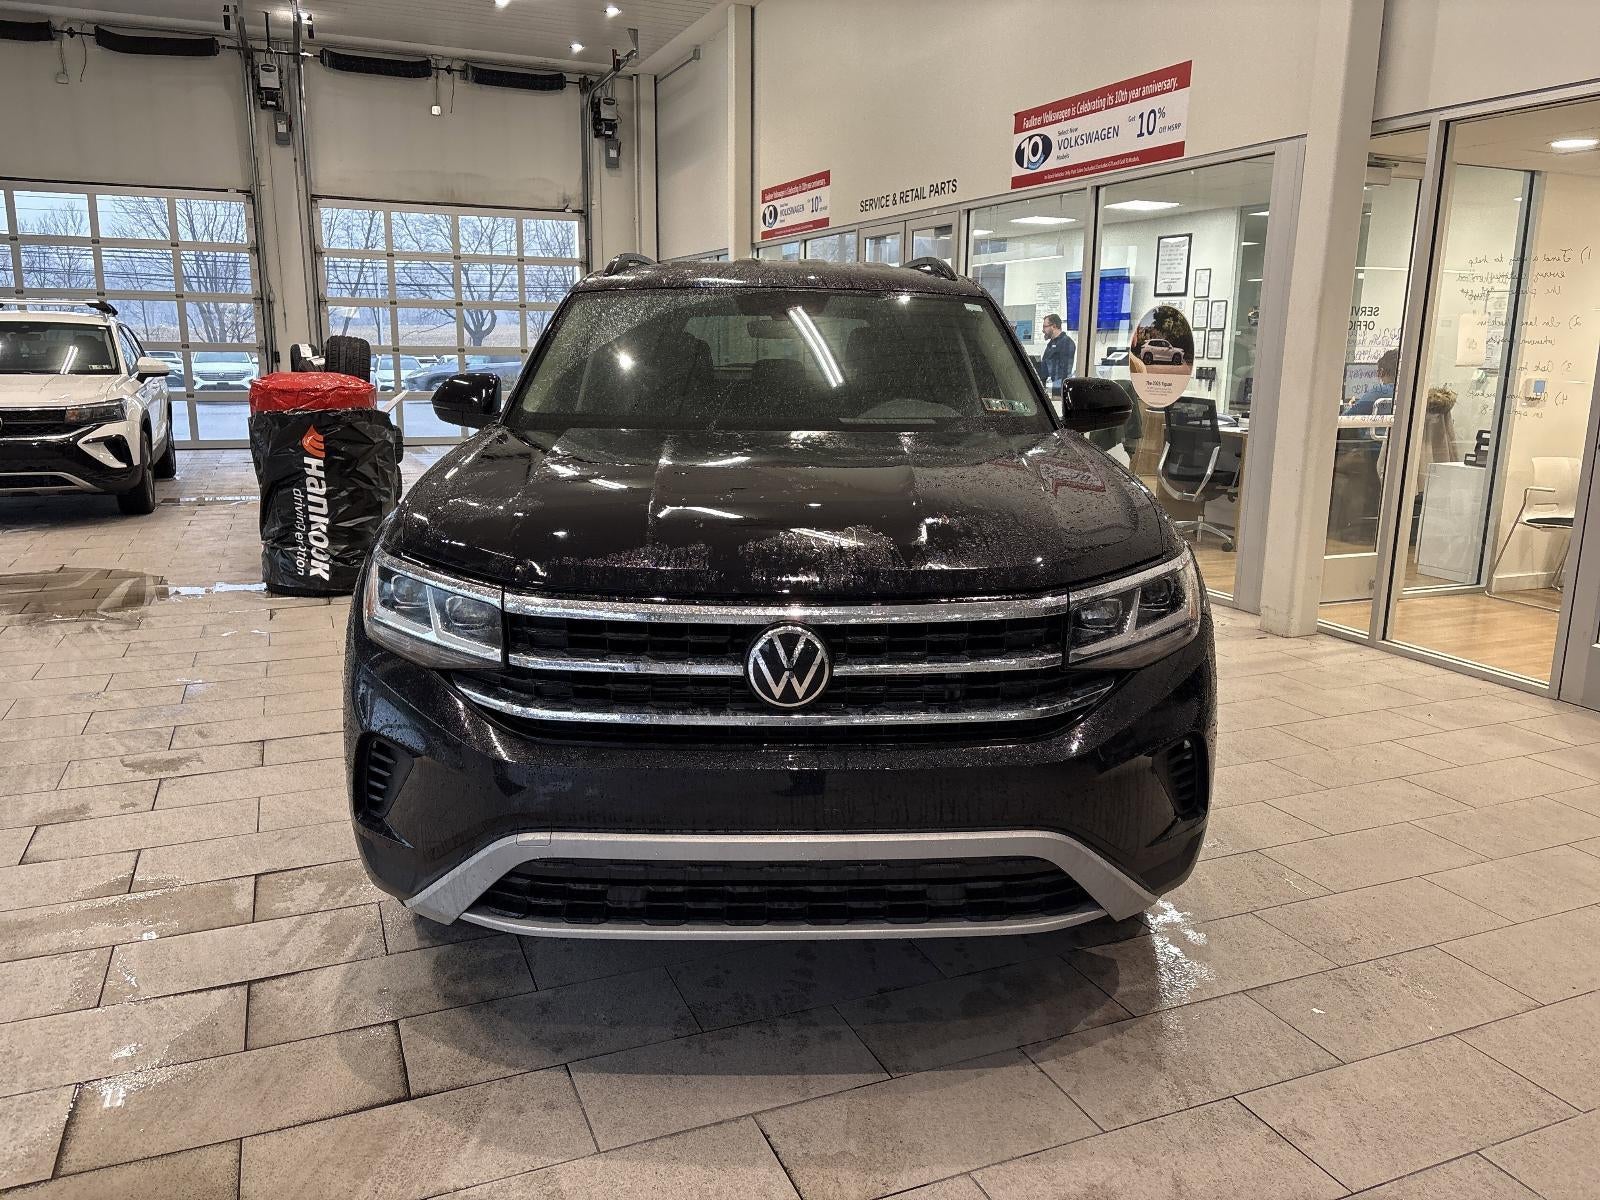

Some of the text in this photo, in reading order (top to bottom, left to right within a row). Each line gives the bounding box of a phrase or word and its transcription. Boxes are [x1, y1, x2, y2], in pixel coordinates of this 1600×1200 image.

[1023, 114, 1042, 129] Faulkner
[1042, 110, 1071, 125] Volkswagen
[1071, 106, 1076, 117] is
[1076, 97, 1106, 115] Celebrating
[1115, 90, 1128, 105] 10th
[1128, 87, 1141, 103] year
[1057, 125, 1120, 151] VOLKSWAGEN
[1167, 123, 1182, 133] MSRP
[1021, 135, 1043, 169] 10
[859, 178, 957, 213] SERVICE & RETAIL PARTS
[293, 488, 306, 532] driving
